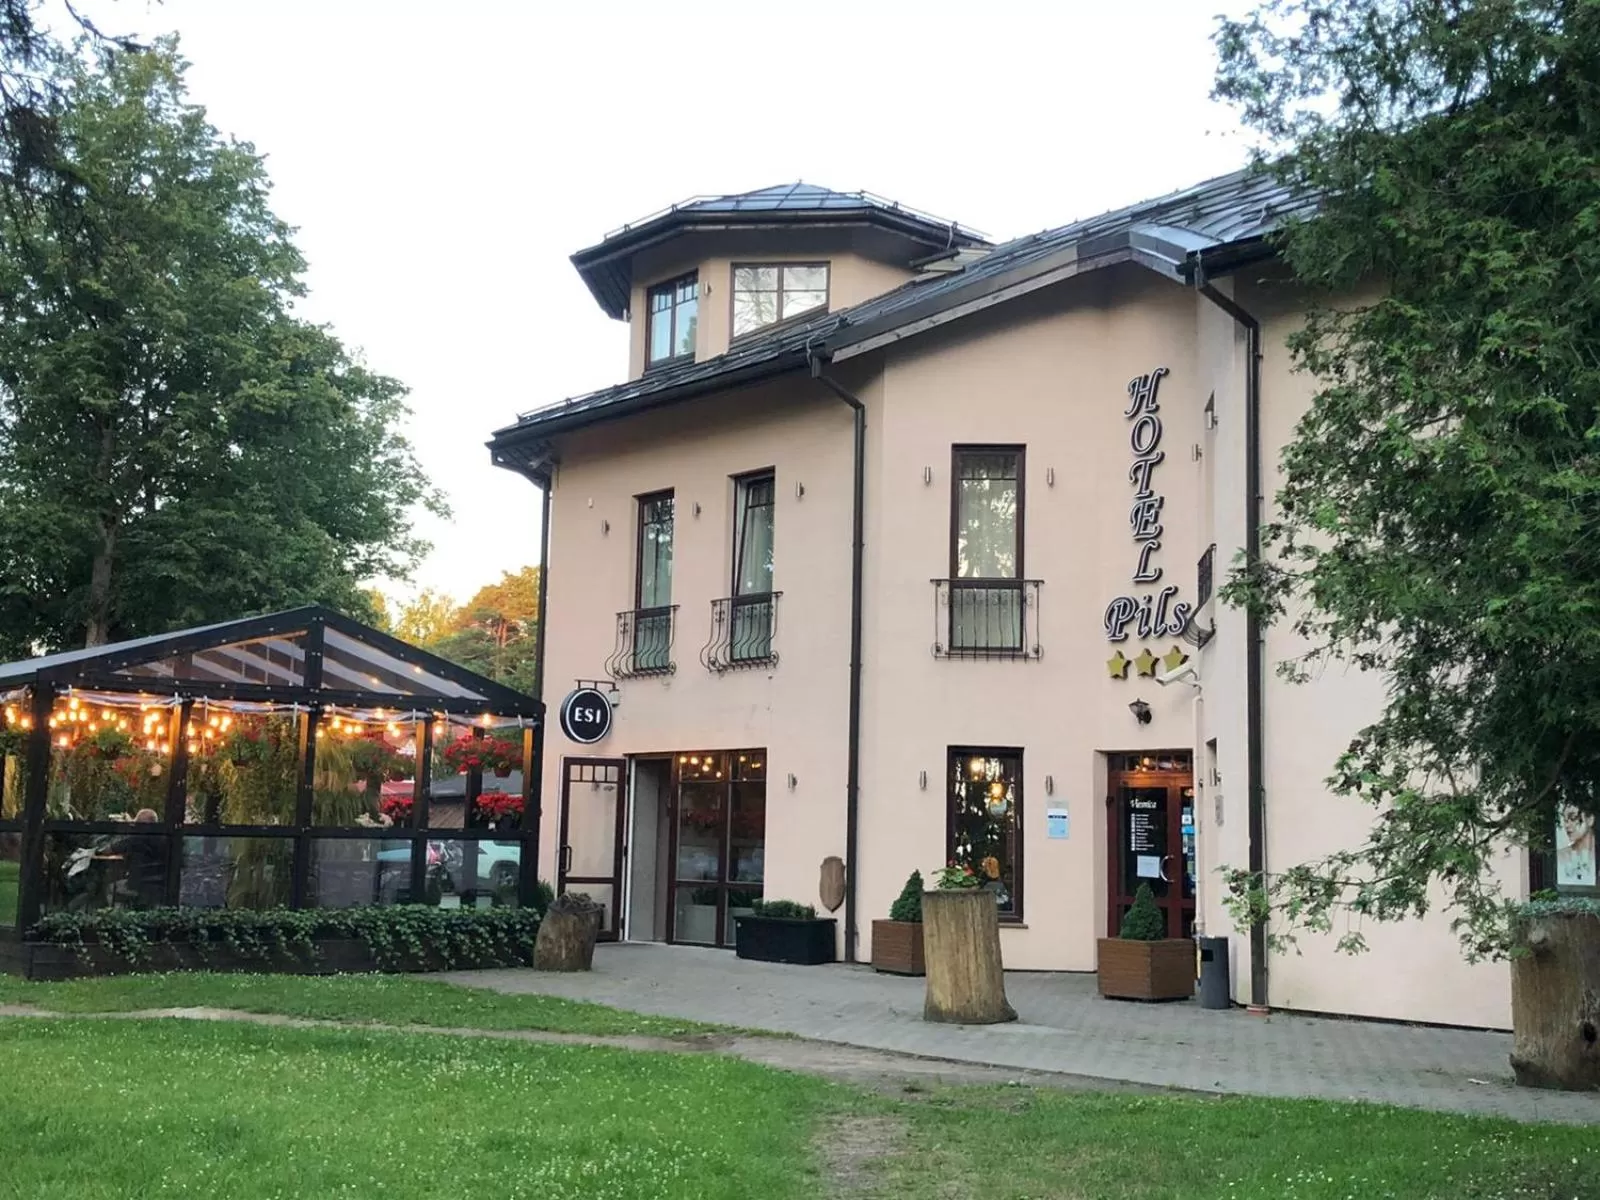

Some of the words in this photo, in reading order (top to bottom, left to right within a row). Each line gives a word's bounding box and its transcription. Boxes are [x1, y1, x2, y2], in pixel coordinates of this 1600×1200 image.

[1125, 367, 1169, 583] HOTEL
[1104, 586, 1191, 642] Pils
[574, 707, 602, 724] ESI
